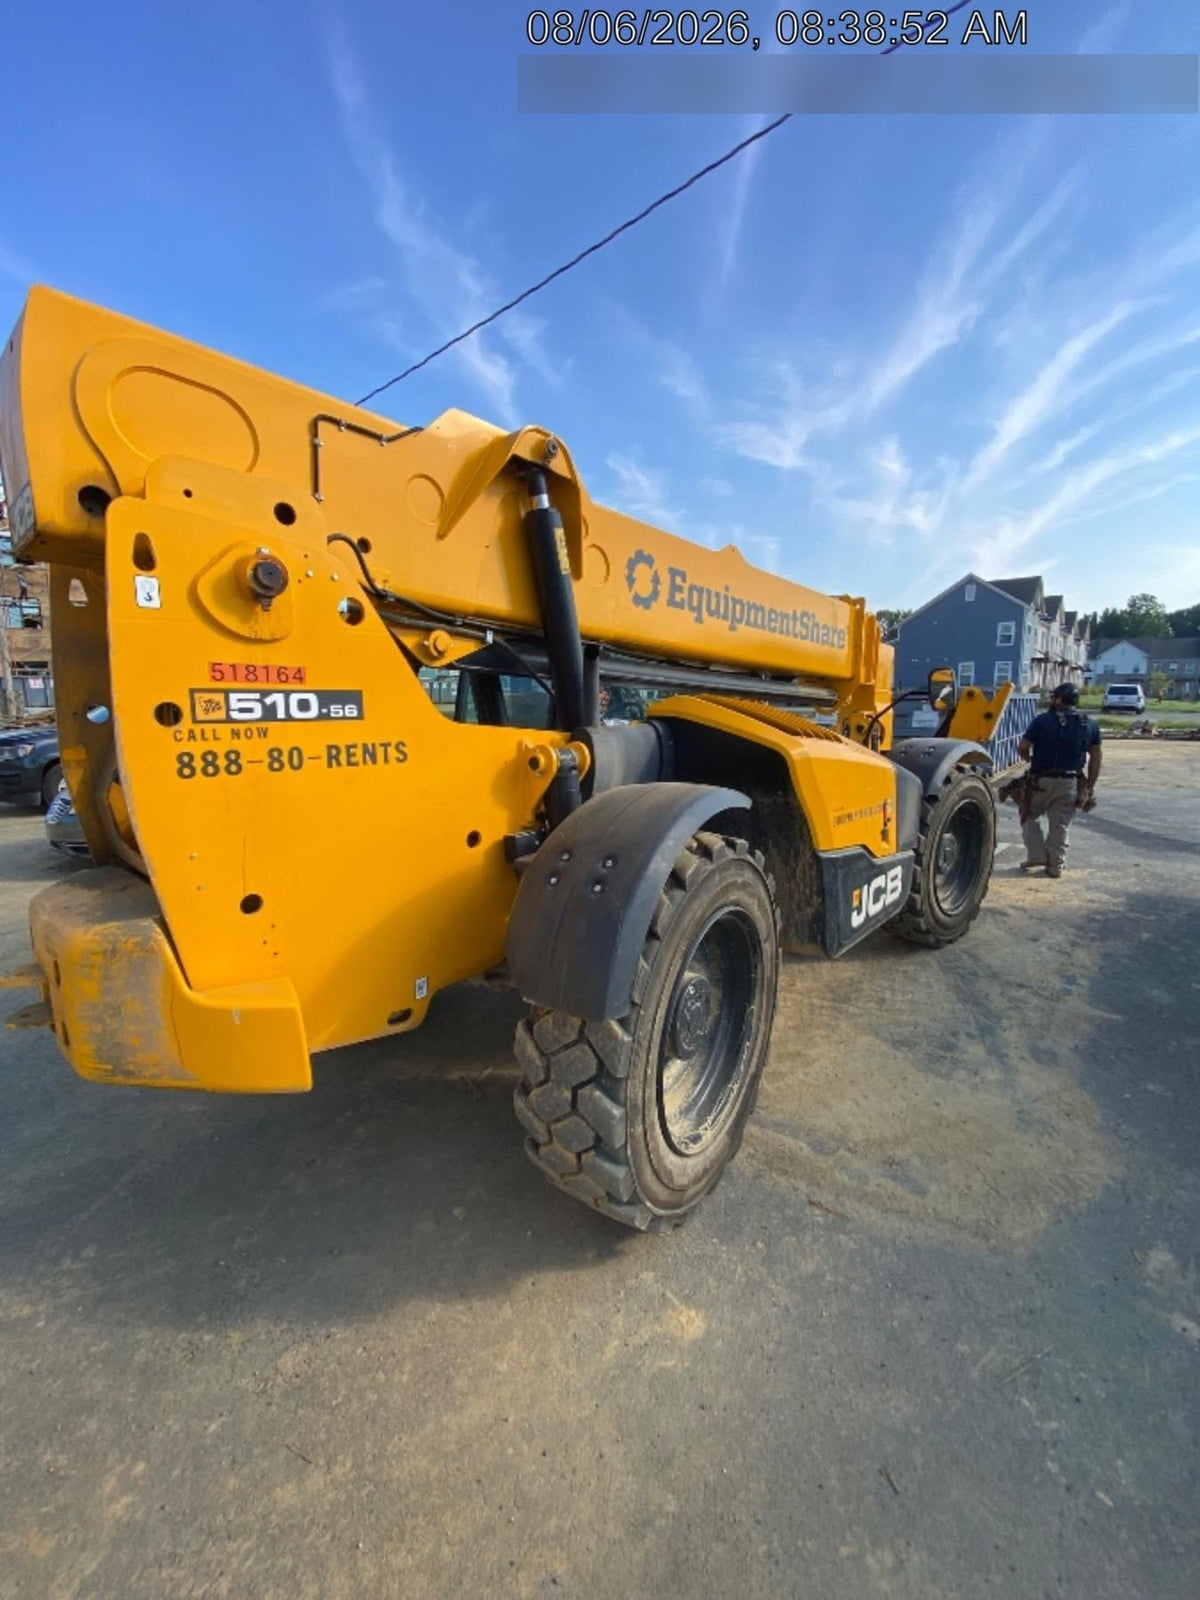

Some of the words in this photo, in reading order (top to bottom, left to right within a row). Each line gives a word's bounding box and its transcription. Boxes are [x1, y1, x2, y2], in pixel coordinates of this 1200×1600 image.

[666, 566, 846, 649] EquipmentShare
[211, 663, 305, 683] 518164
[173, 728, 221, 742] CALL
[231, 727, 269, 740] NOW
[176, 741, 408, 779] 888-80-RENTS
[851, 865, 902, 928] JCB
